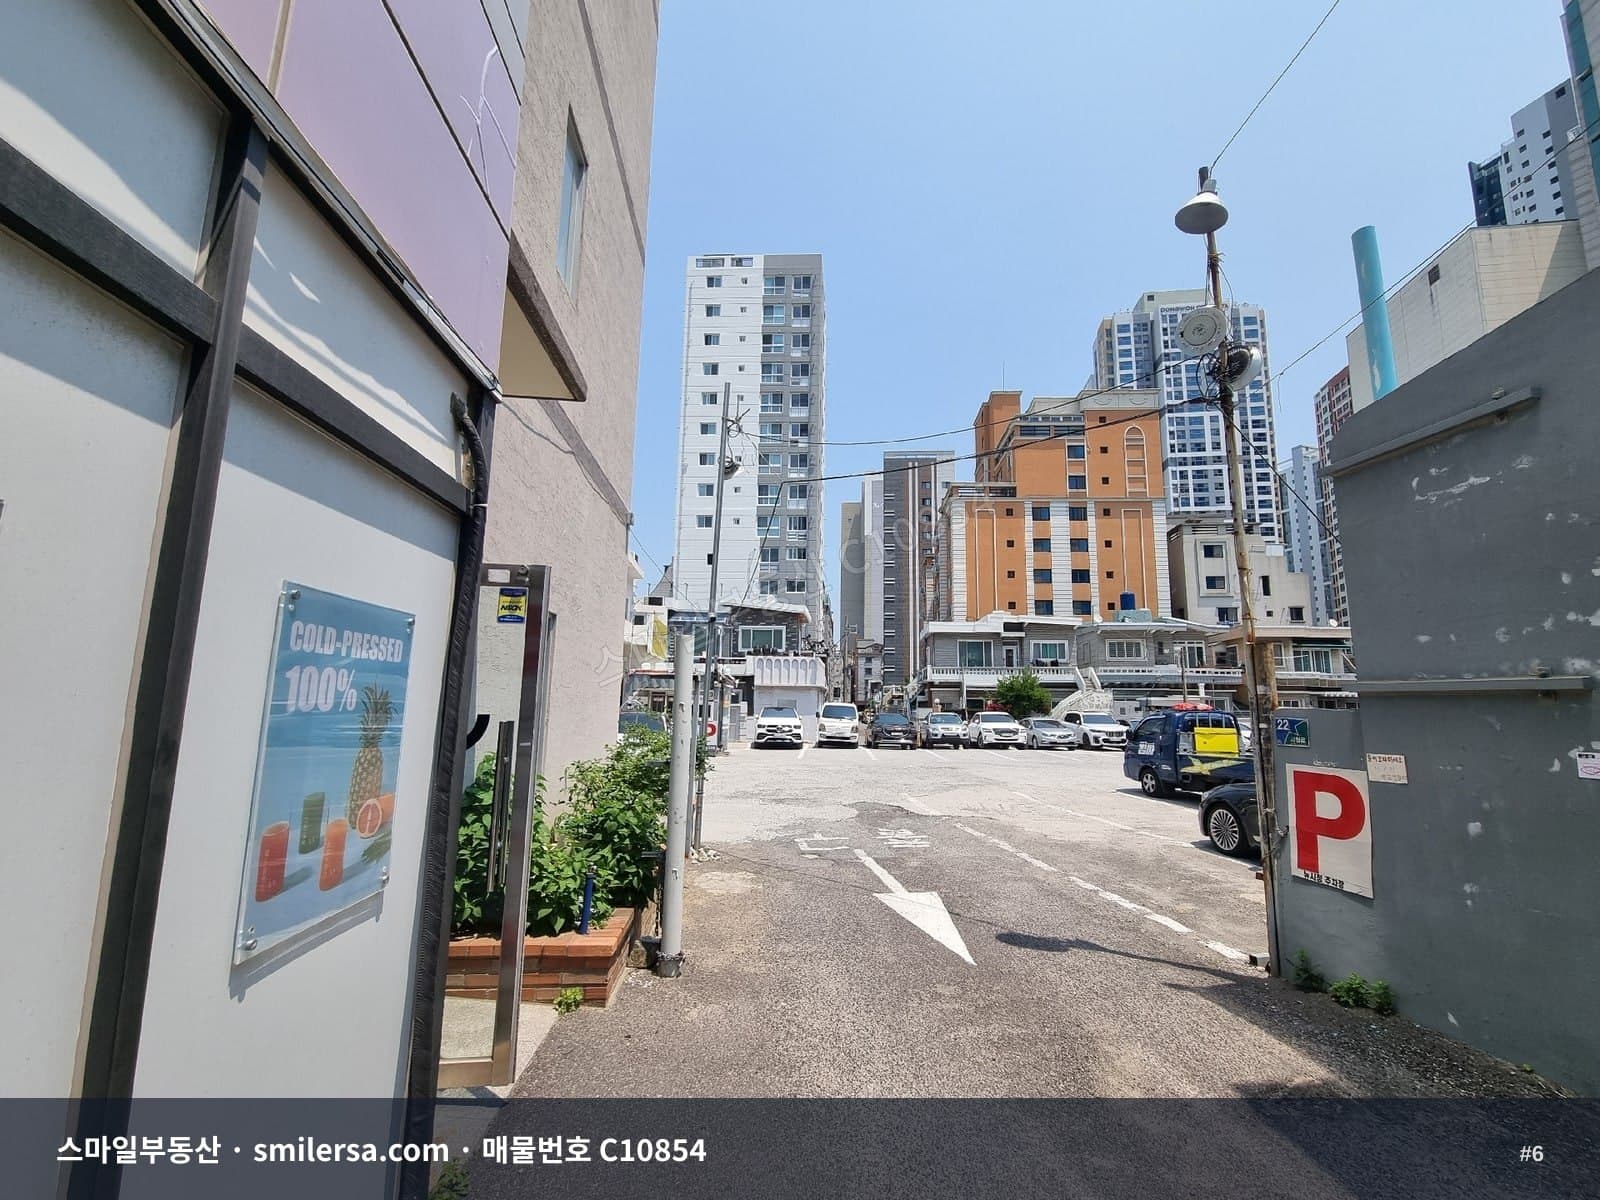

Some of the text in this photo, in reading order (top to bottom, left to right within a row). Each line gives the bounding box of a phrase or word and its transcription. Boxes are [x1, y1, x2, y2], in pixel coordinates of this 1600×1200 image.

[290, 620, 404, 662] COLD-PRESSED
[285, 665, 357, 712] 100%
[1277, 719, 1289, 730] 22
[1293, 770, 1365, 873] P
[1325, 875, 1344, 889] 주차장
